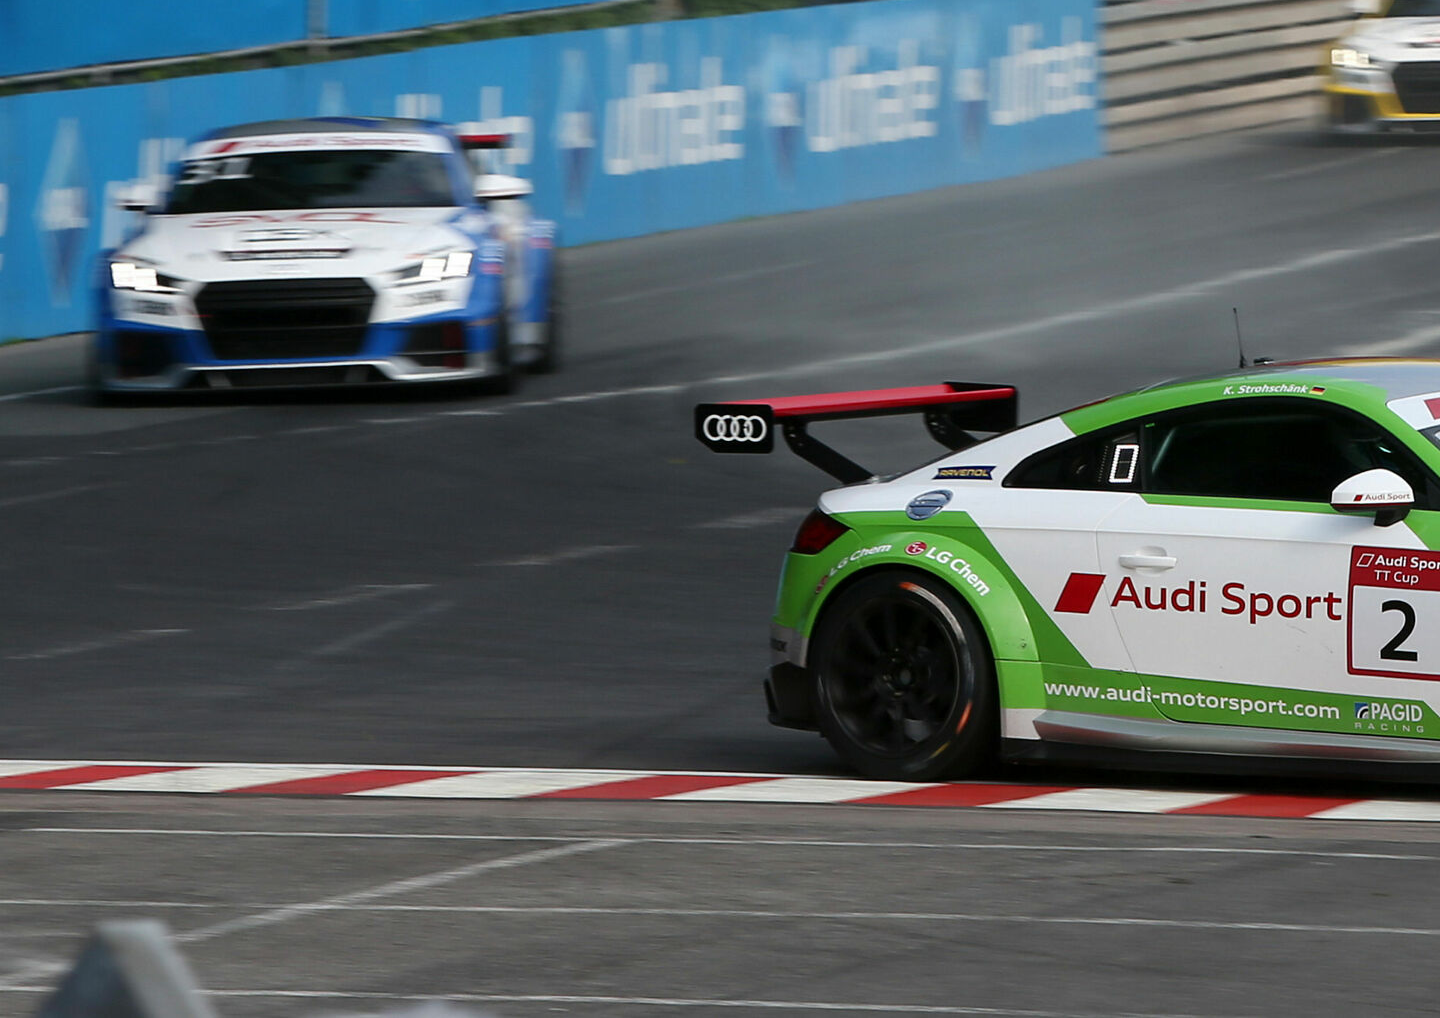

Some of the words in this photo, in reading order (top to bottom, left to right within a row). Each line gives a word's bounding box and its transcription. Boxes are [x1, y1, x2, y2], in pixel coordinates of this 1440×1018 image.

[1223, 384, 1235, 395] K.
[1238, 383, 1308, 394] Strohschänk
[1365, 493, 1385, 501] Audi
[1388, 493, 1411, 502] Sport
[850, 544, 892, 561] Chem
[1375, 554, 1407, 568] Audi
[925, 546, 952, 565] LG
[950, 558, 990, 596] Chem
[1374, 570, 1390, 582] TT
[1394, 570, 1419, 586] Cup
[1111, 576, 1207, 614] Audi
[1221, 582, 1342, 625] Sport
[1380, 599, 1418, 662] 2
[1044, 682, 1340, 720] www.audi-motorsport.com
[1369, 702, 1423, 722] PAGID
[1354, 722, 1425, 734] RACING
